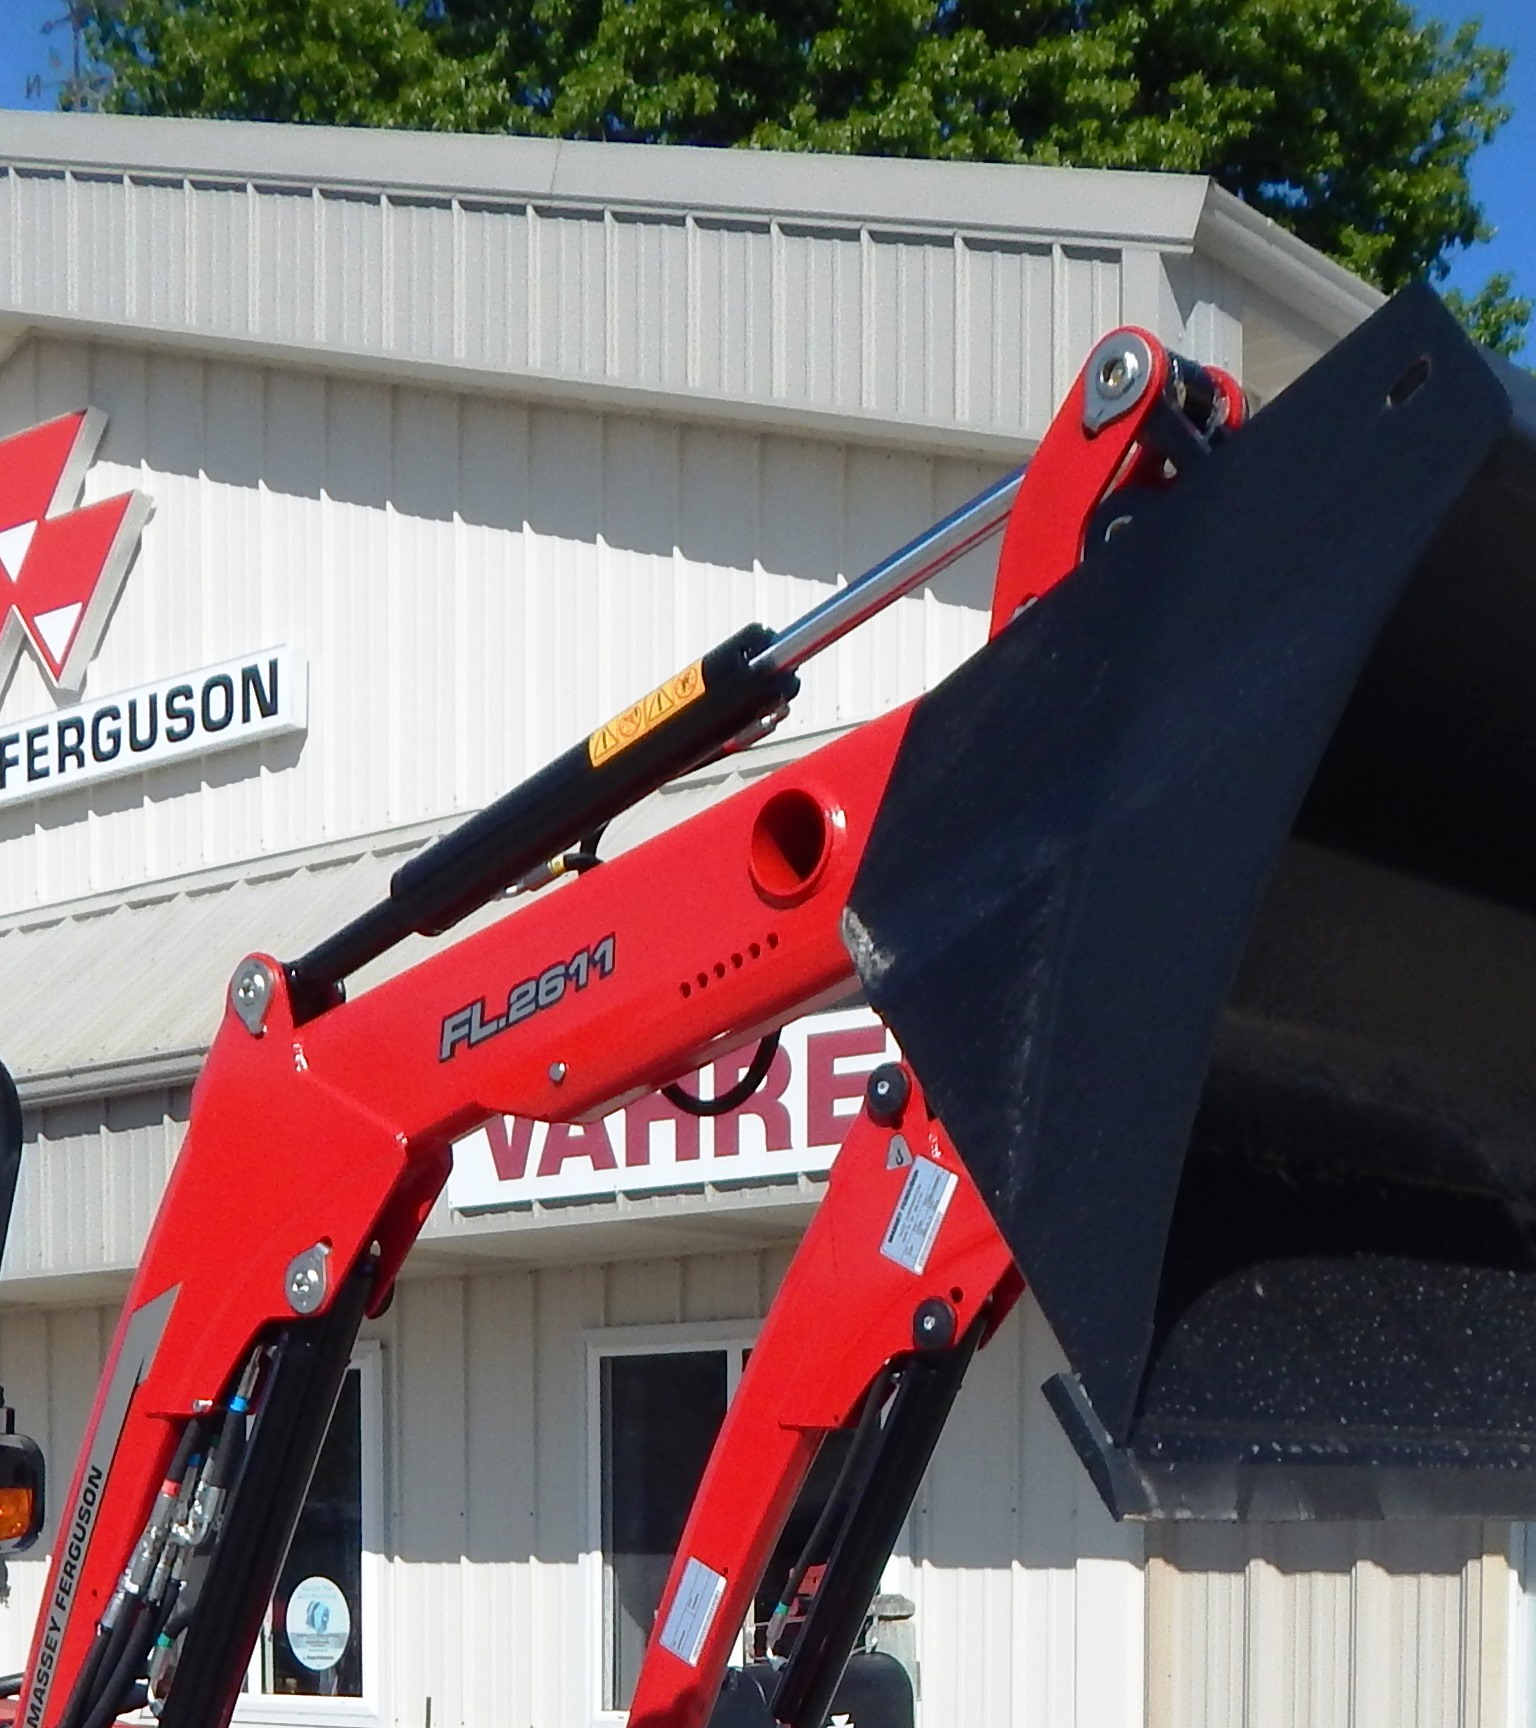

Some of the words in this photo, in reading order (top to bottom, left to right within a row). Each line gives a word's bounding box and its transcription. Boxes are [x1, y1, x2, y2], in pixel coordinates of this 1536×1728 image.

[439, 932, 616, 1062] FL.2611
[26, 1615, 62, 1728] MASSEY
[55, 1465, 103, 1611] FERGUSON
